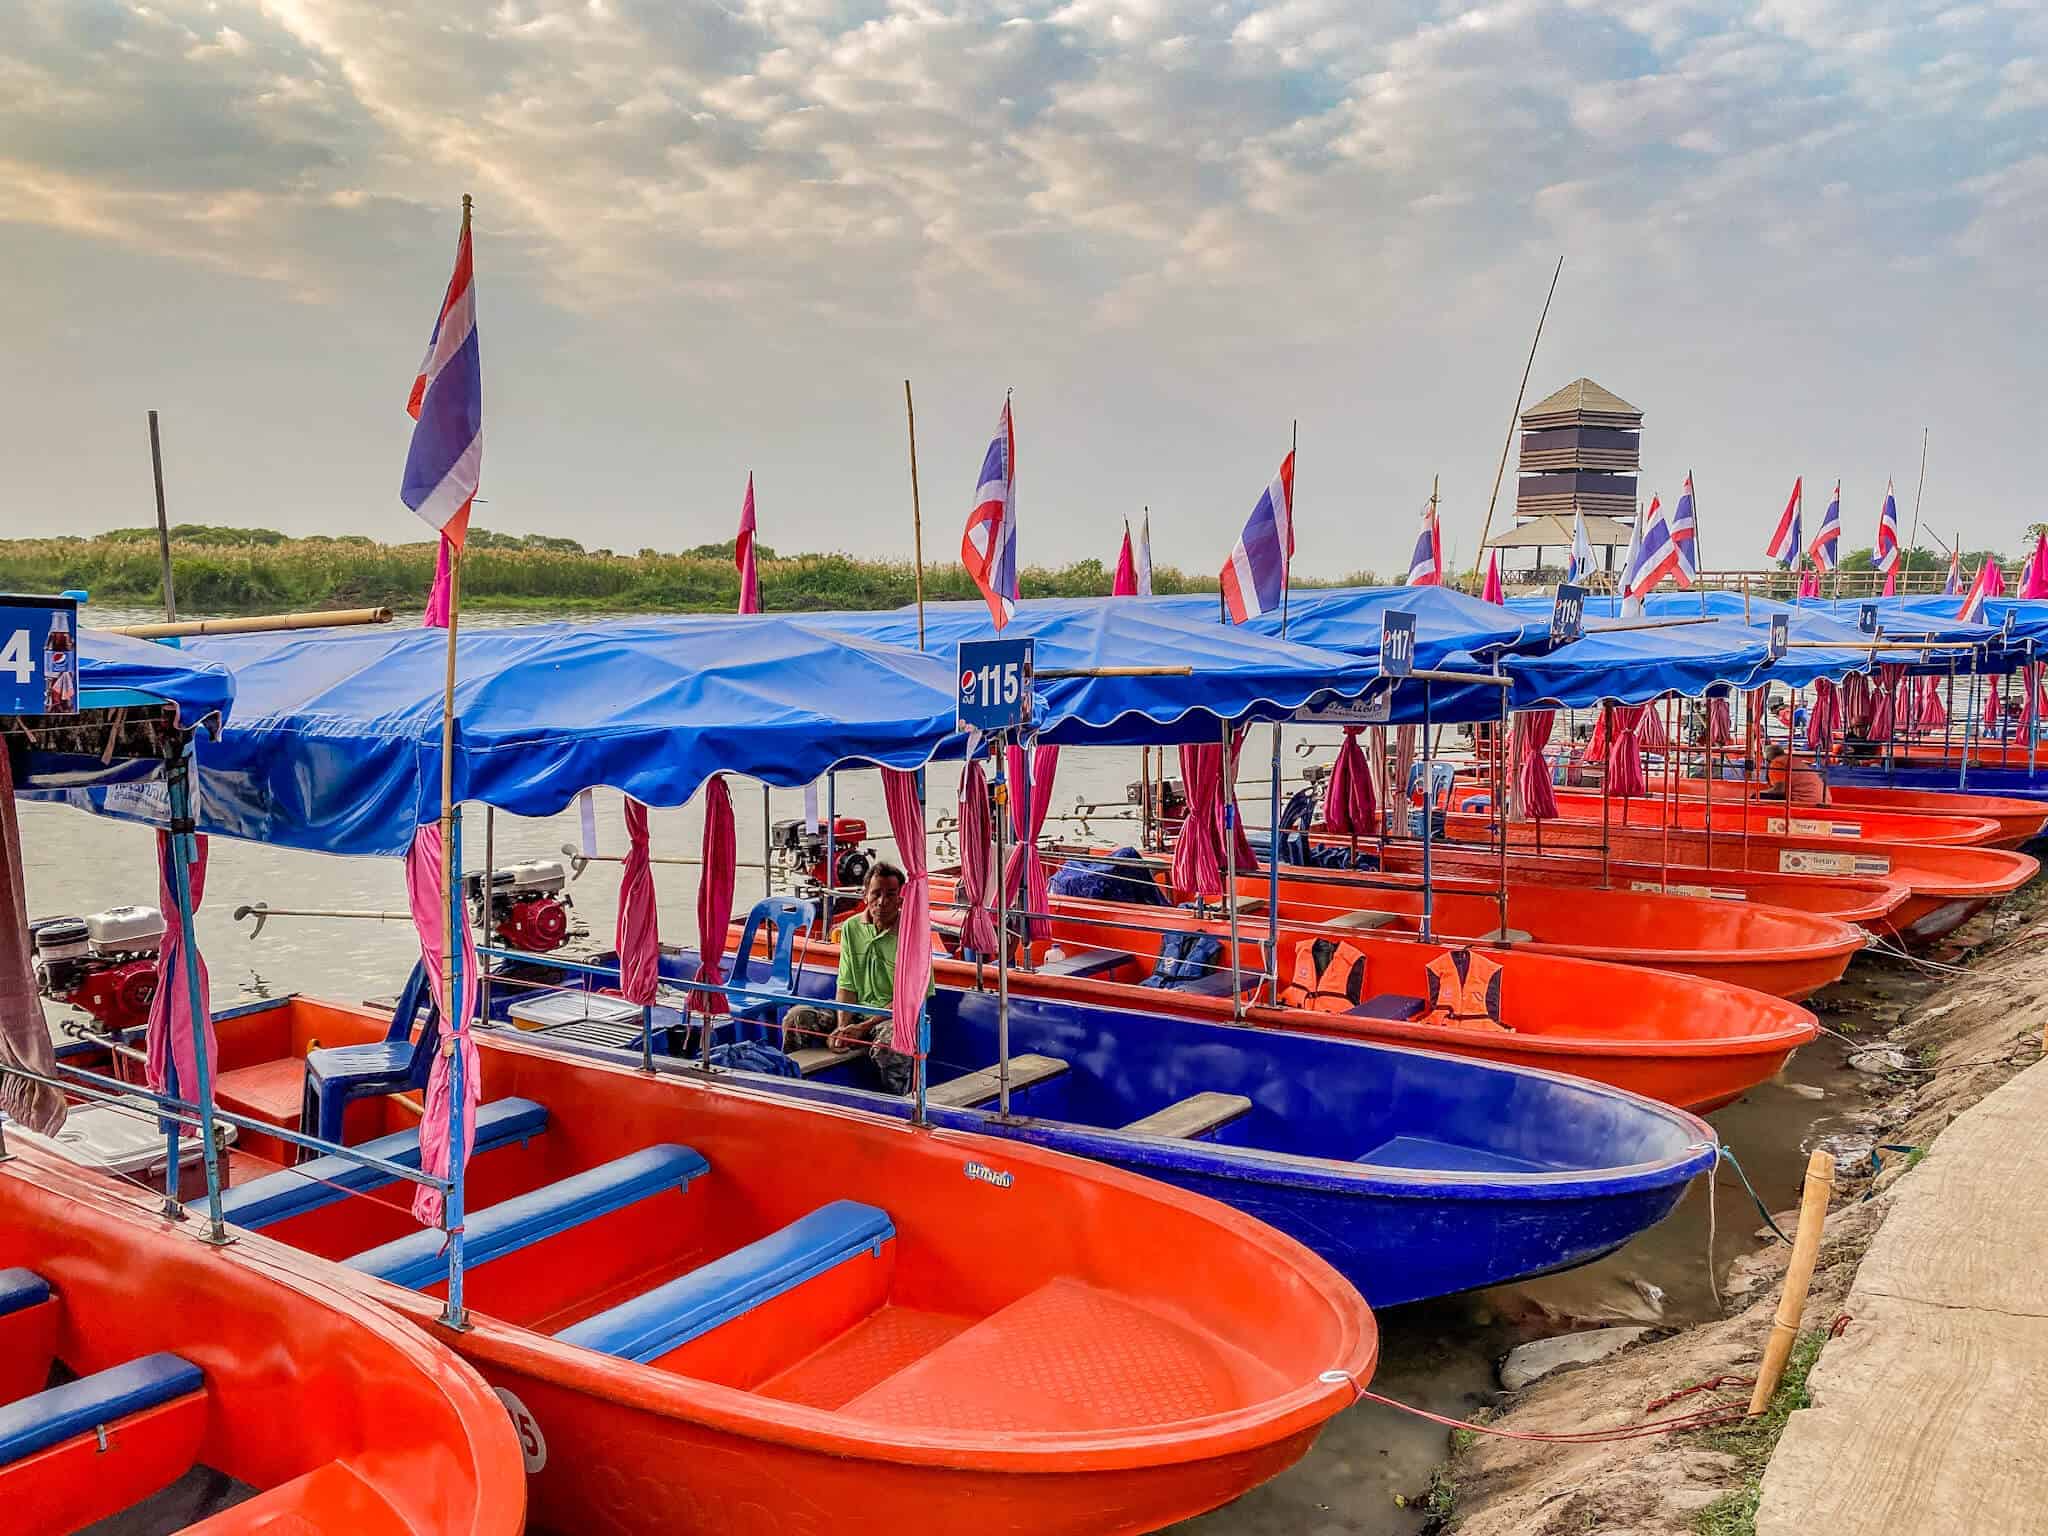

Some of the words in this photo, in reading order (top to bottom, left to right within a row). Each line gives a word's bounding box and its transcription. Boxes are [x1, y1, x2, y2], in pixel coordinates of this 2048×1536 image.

[1561, 600, 1577, 624] 119
[1392, 629, 1409, 661] 117
[978, 663, 1018, 707] 115
[510, 1409, 539, 1457] 5
